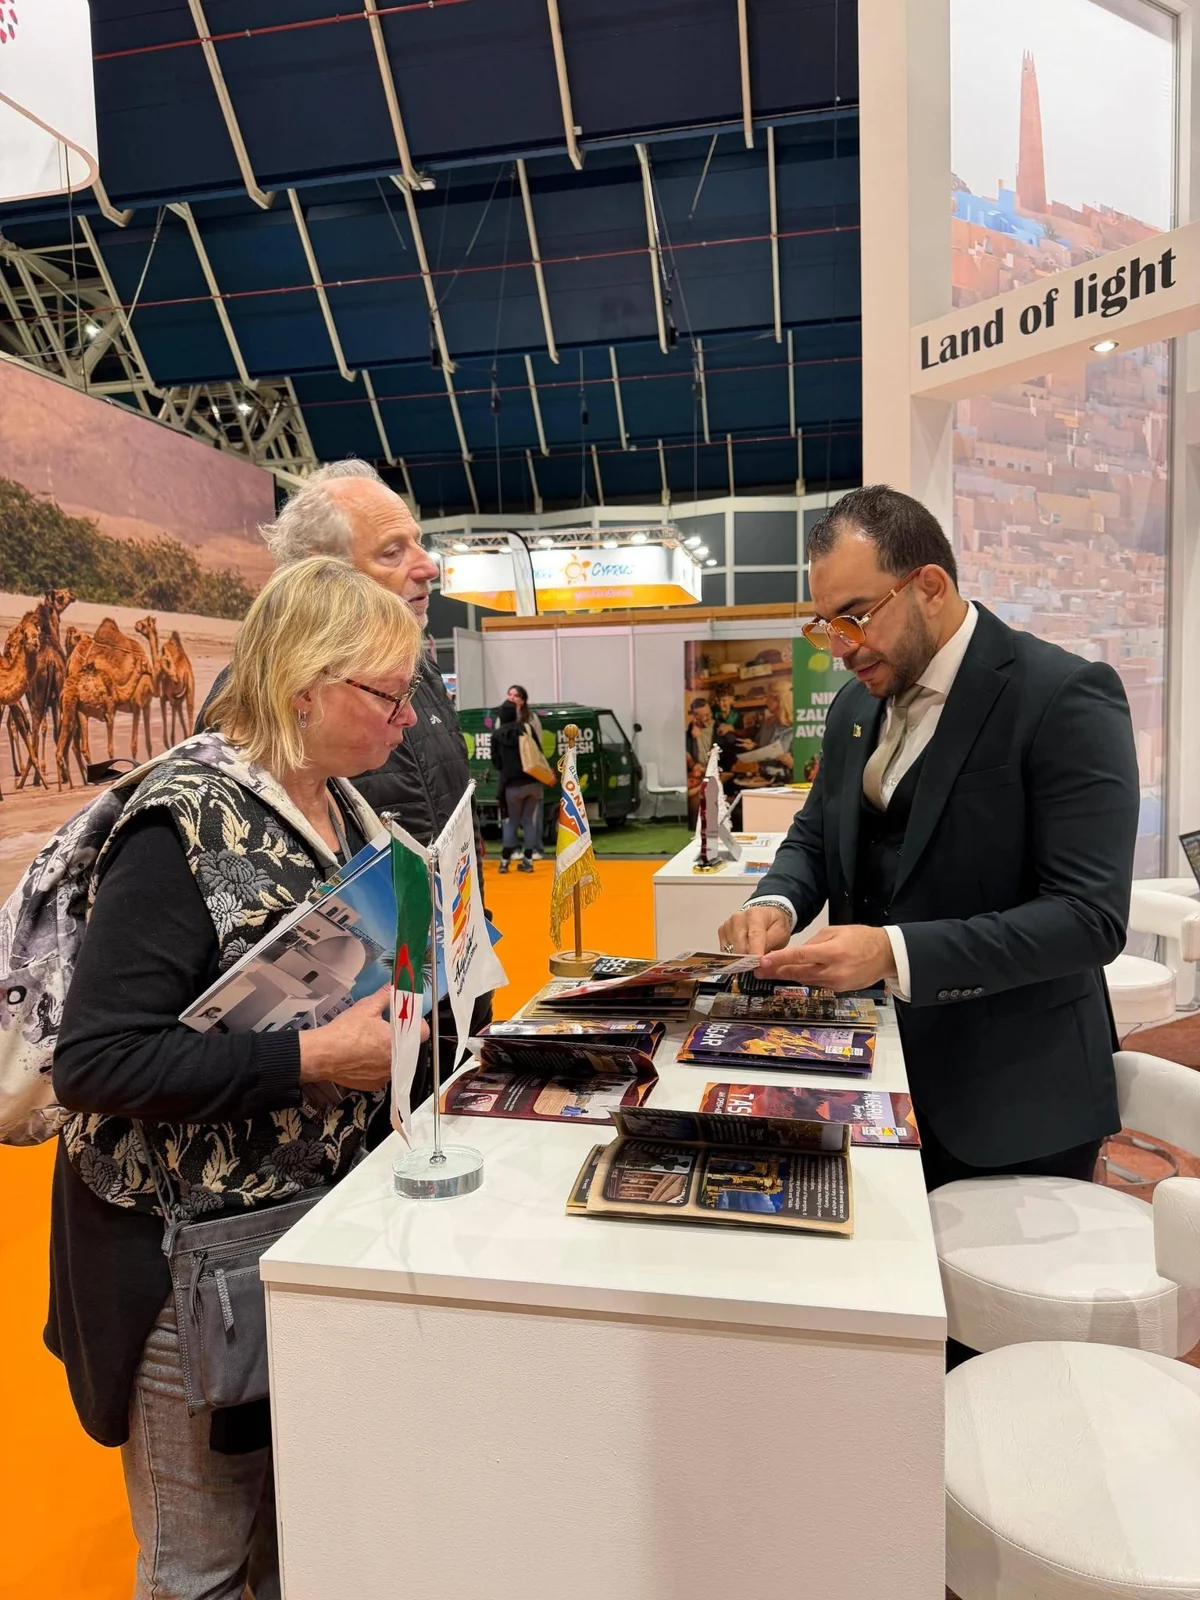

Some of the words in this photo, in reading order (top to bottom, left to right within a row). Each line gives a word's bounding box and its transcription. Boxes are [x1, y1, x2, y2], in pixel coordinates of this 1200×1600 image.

[921, 307, 1004, 370] Land
[1019, 287, 1059, 335] of
[1074, 247, 1177, 318] light
[811, 692, 837, 705] NI
[796, 708, 829, 722] ZAL
[557, 727, 594, 743] HLO
[795, 724, 827, 738] AVO
[475, 732, 492, 747] HE
[475, 747, 492, 760] FR
[557, 741, 595, 757] FSH
[727, 1092, 755, 1116] TAS
